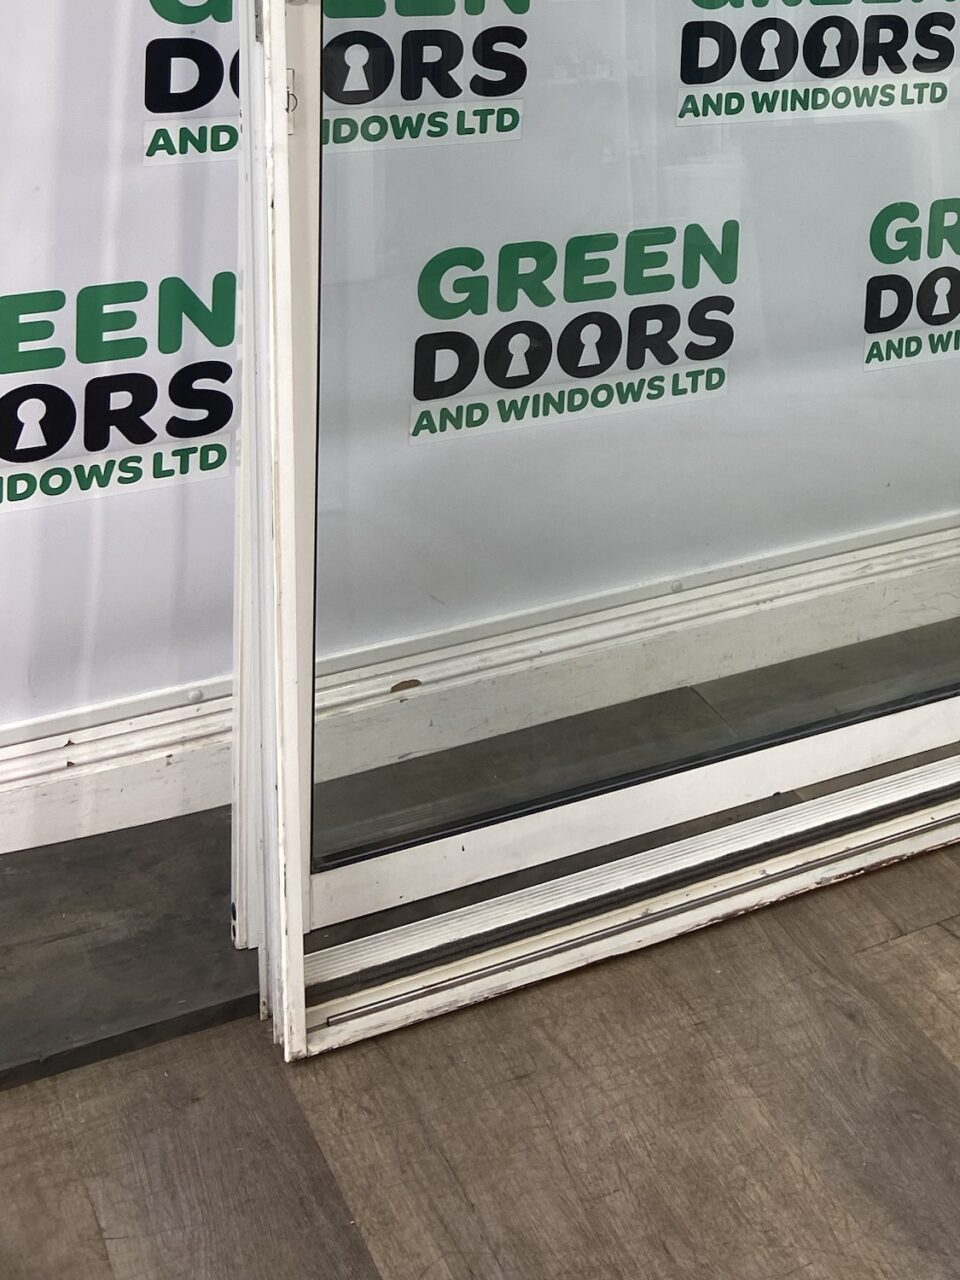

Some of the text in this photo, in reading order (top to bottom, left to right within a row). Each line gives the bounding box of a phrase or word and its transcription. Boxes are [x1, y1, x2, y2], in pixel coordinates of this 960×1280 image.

[680, 12, 955, 84] DOORS
[678, 81, 947, 118] AND WINDOWS LTD
[146, 124, 239, 157] AND
[456, 106, 520, 136] LTD
[418, 220, 739, 320] GREEN
[413, 296, 734, 401] DOORS
[866, 332, 922, 364] AND
[411, 367, 725, 437] AND WINDOWS LTD
[153, 443, 227, 478] LTD
